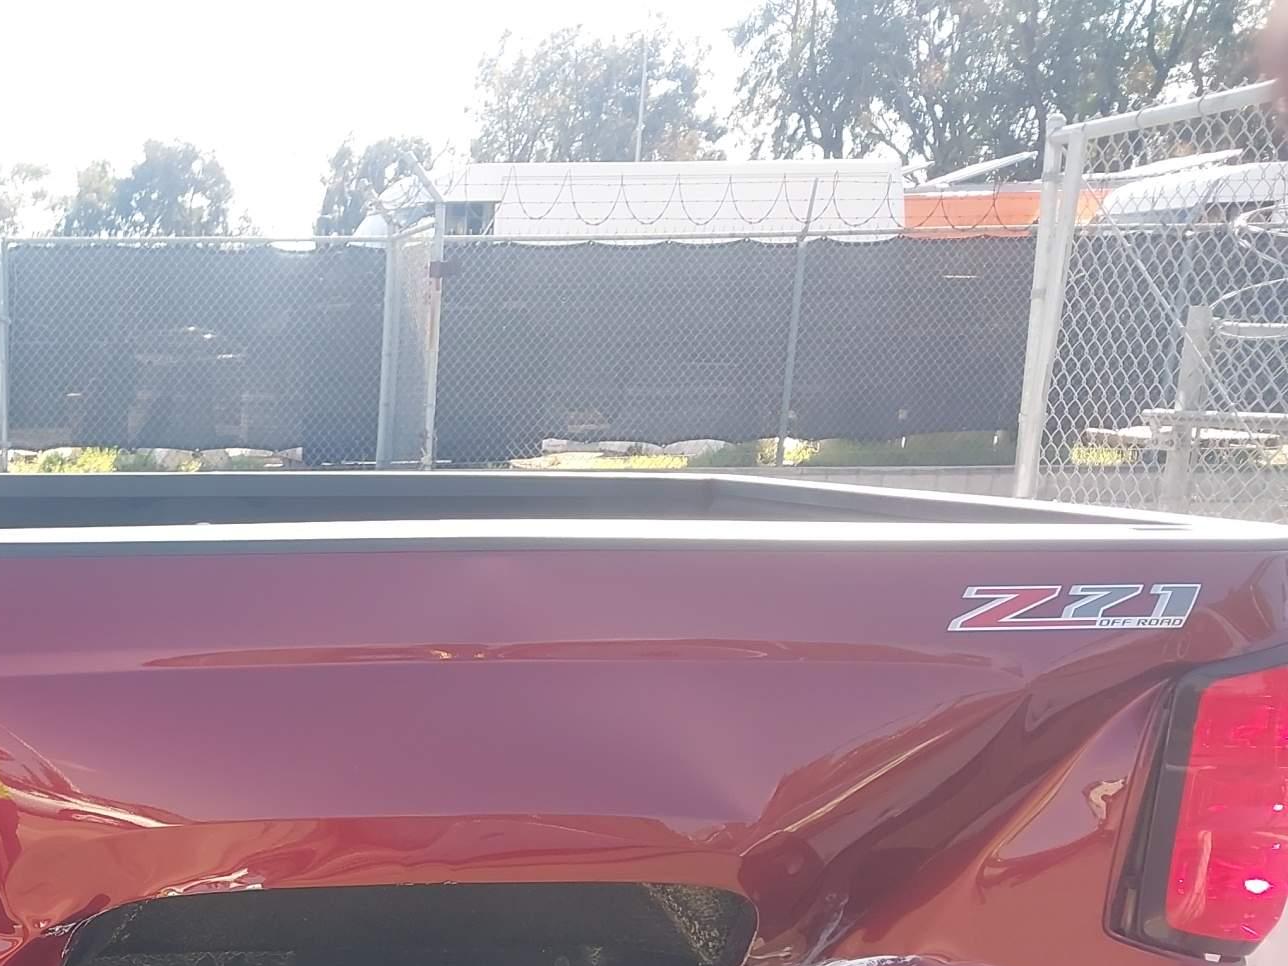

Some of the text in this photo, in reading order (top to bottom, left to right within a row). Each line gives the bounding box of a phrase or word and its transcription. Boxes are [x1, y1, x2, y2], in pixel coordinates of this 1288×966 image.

[947, 583, 1202, 631] Z71
[1098, 618, 1184, 627] OFF ROAD
